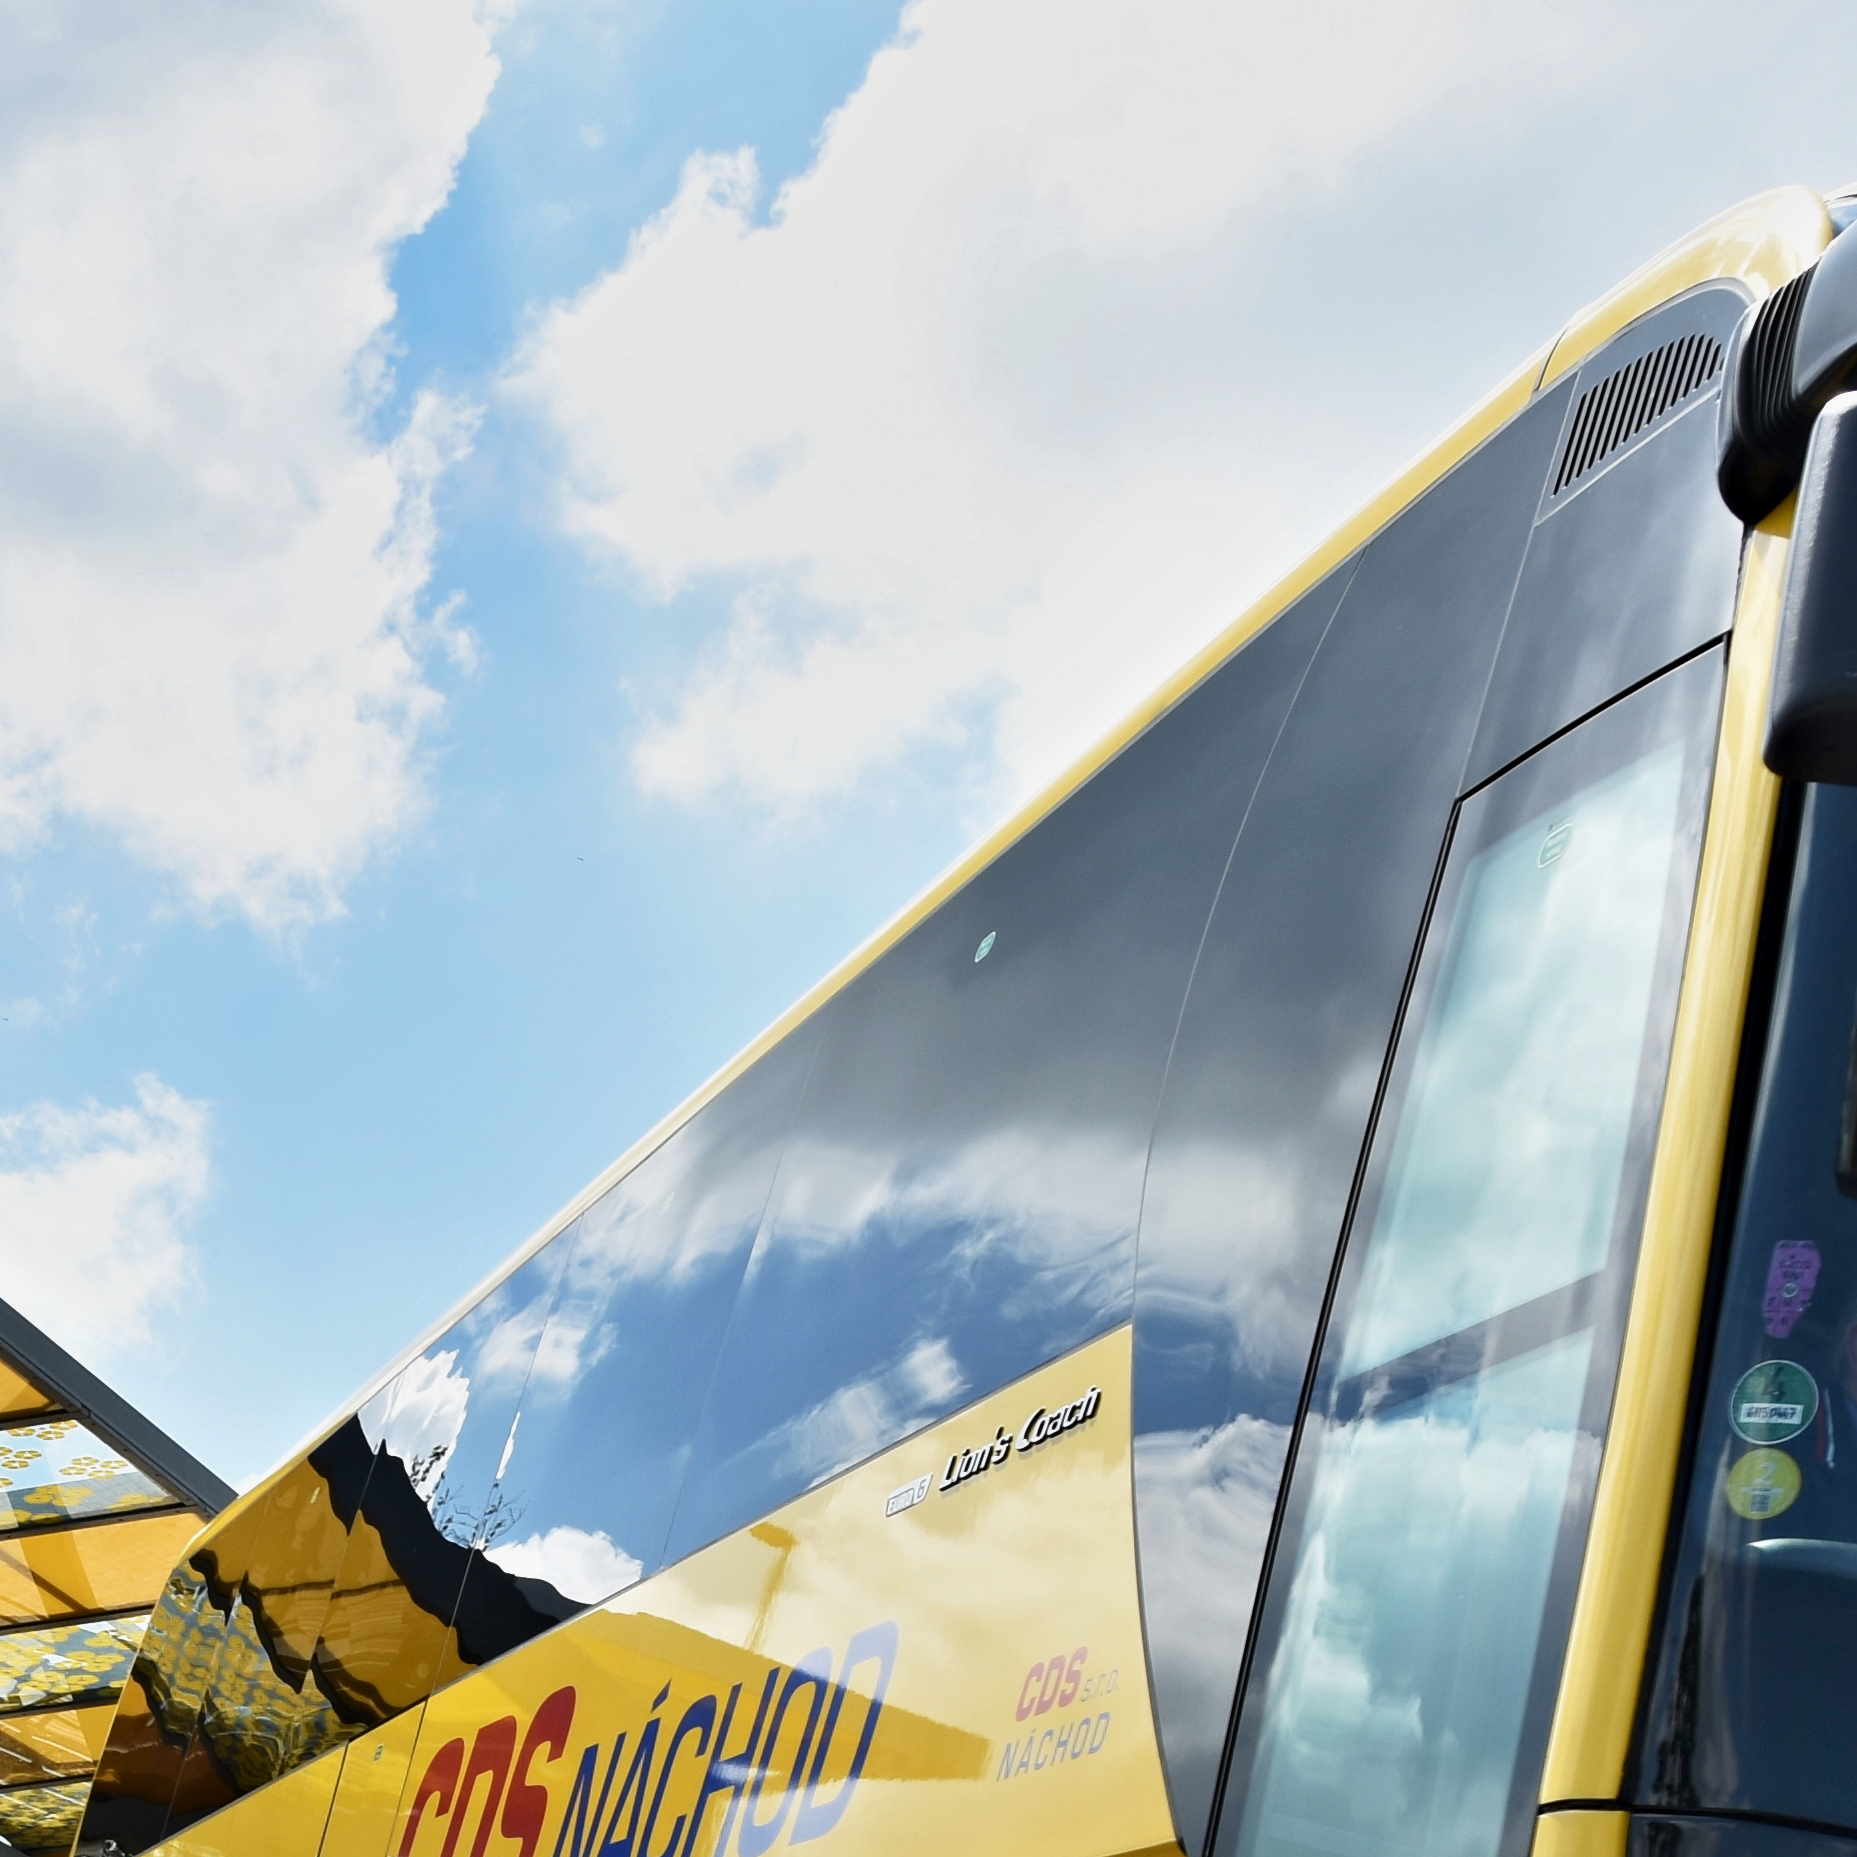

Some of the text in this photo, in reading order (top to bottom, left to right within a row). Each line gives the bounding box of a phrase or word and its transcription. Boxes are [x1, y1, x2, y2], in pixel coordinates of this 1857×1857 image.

[939, 1385, 1102, 1492] Lion's Coach
[1015, 1646, 1088, 1722] CDS
[996, 1711, 1111, 1782] NÁCHOD
